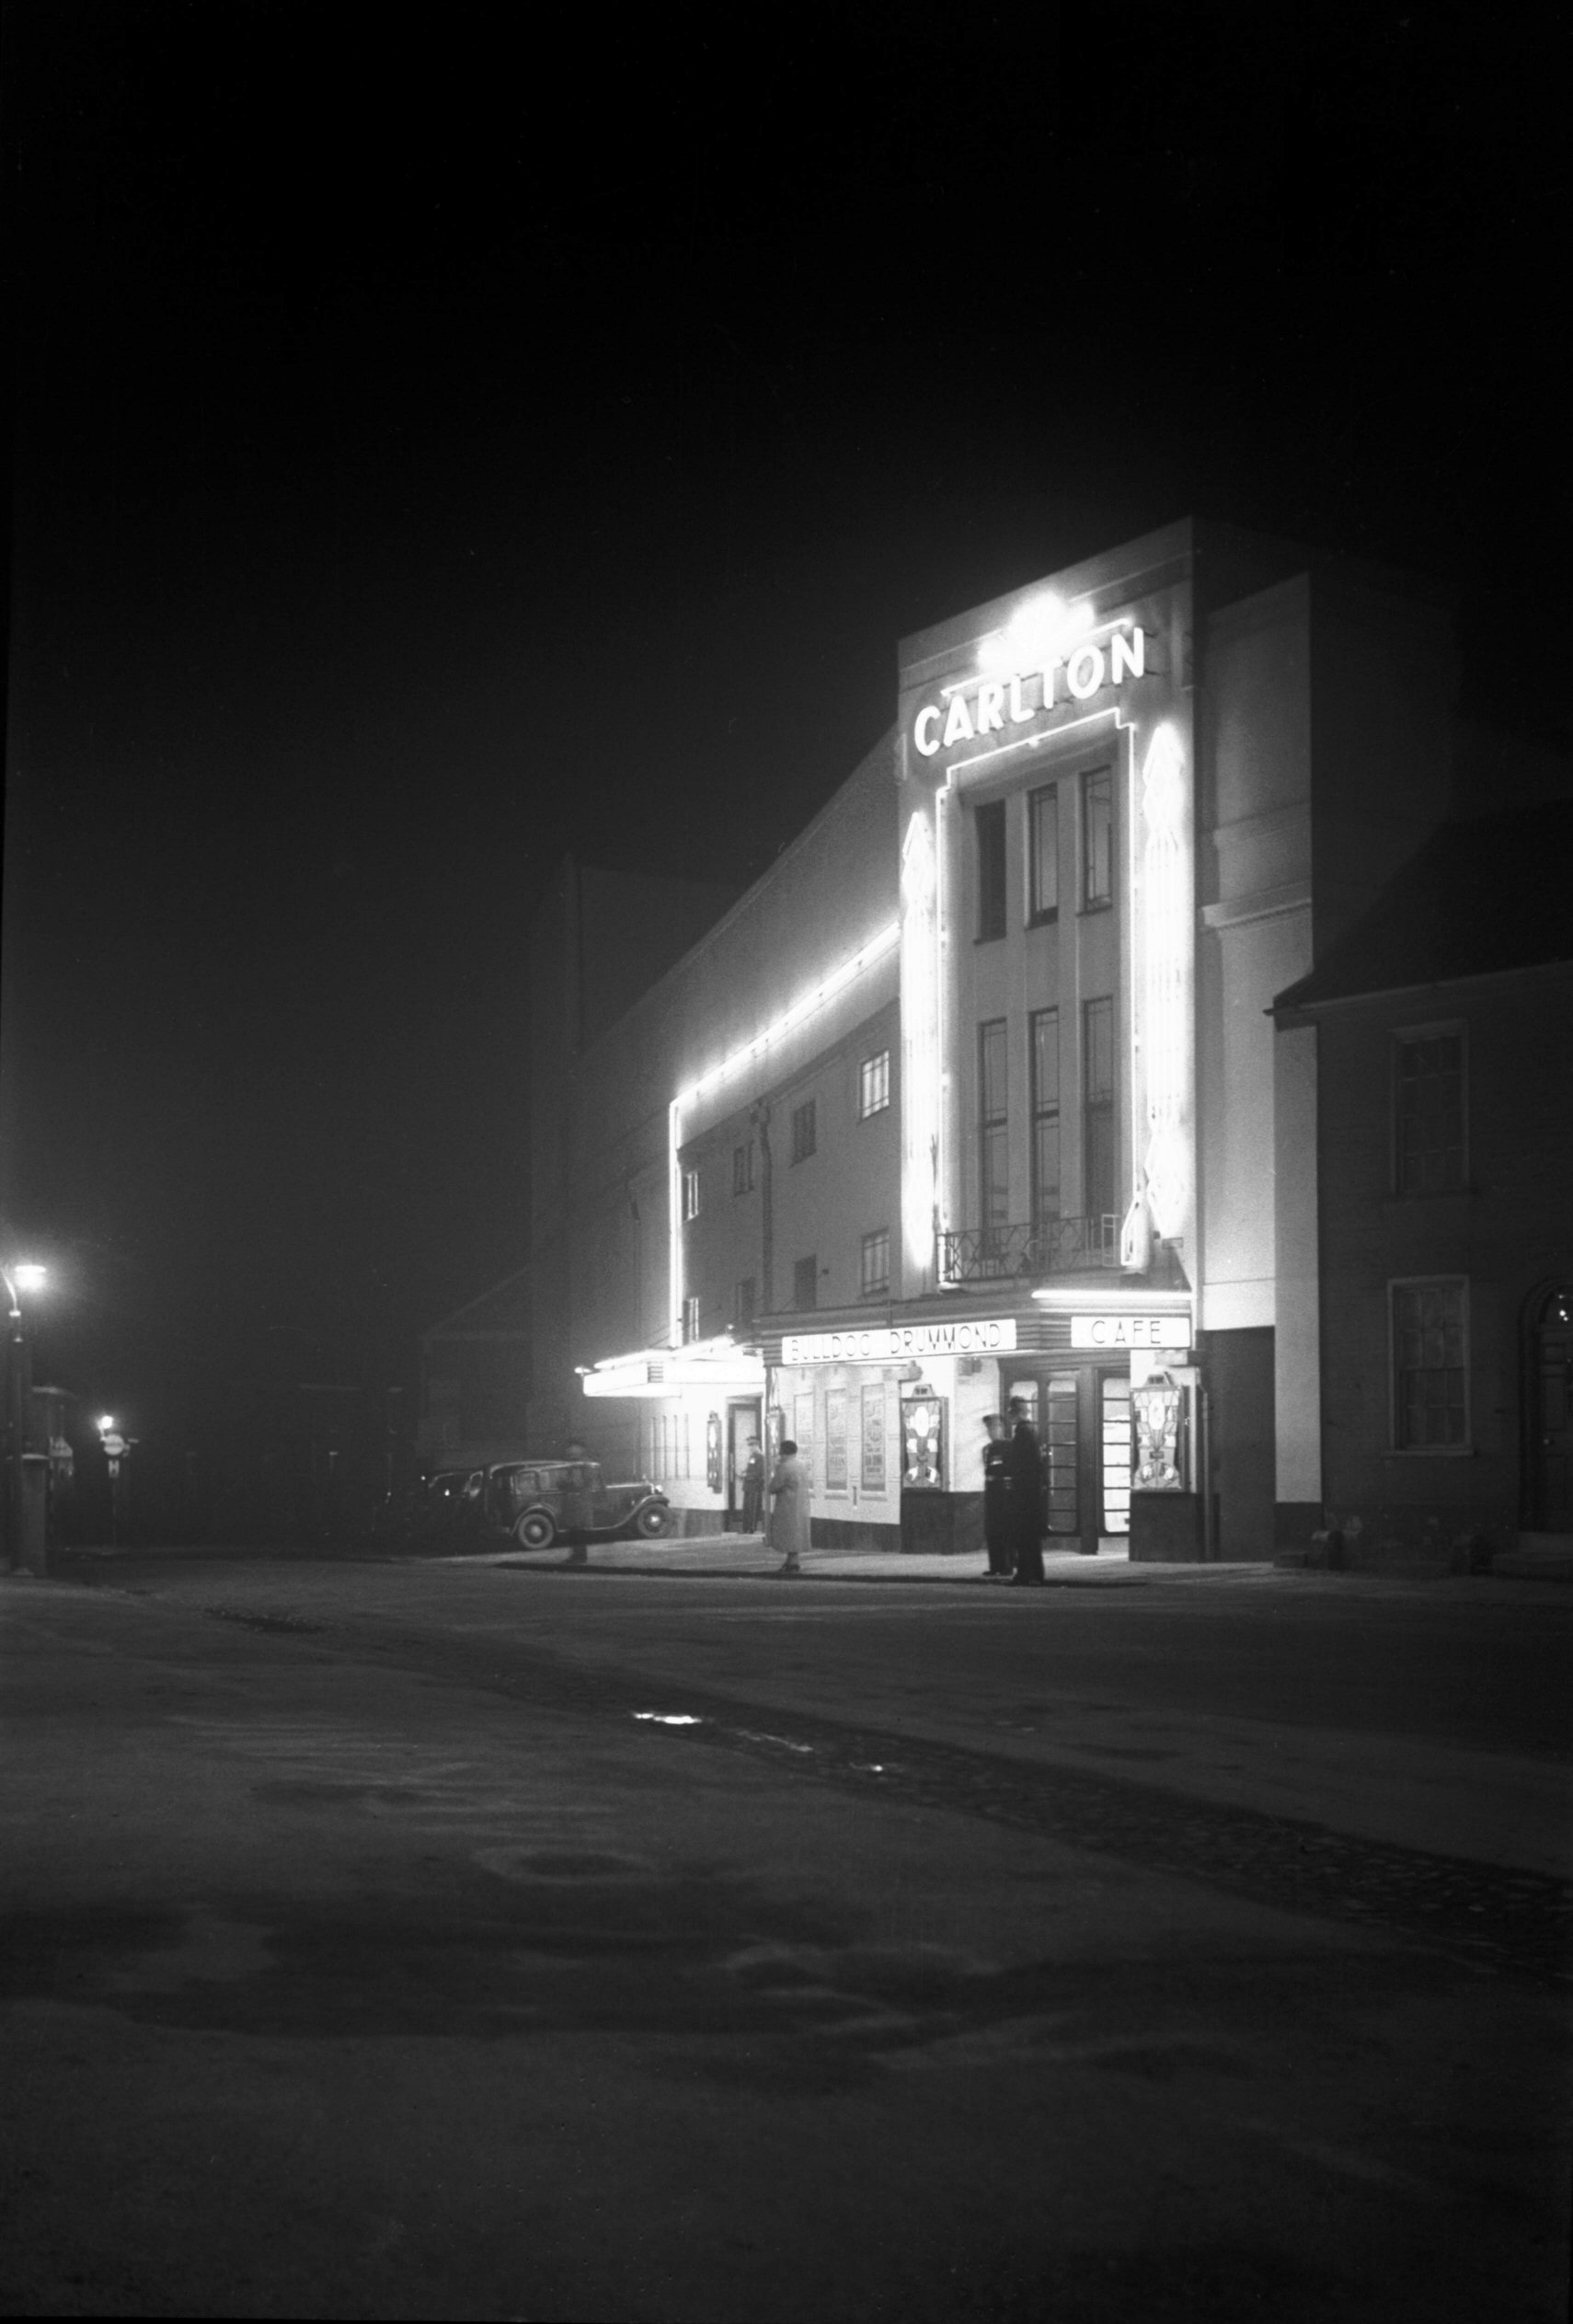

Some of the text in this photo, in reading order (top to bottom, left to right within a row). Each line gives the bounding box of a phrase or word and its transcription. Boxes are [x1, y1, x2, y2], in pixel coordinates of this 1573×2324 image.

[914, 627, 1144, 756] CARLTON
[890, 1323, 1001, 1354] DRUMMOND
[1091, 1320, 1161, 1344] CAFE
